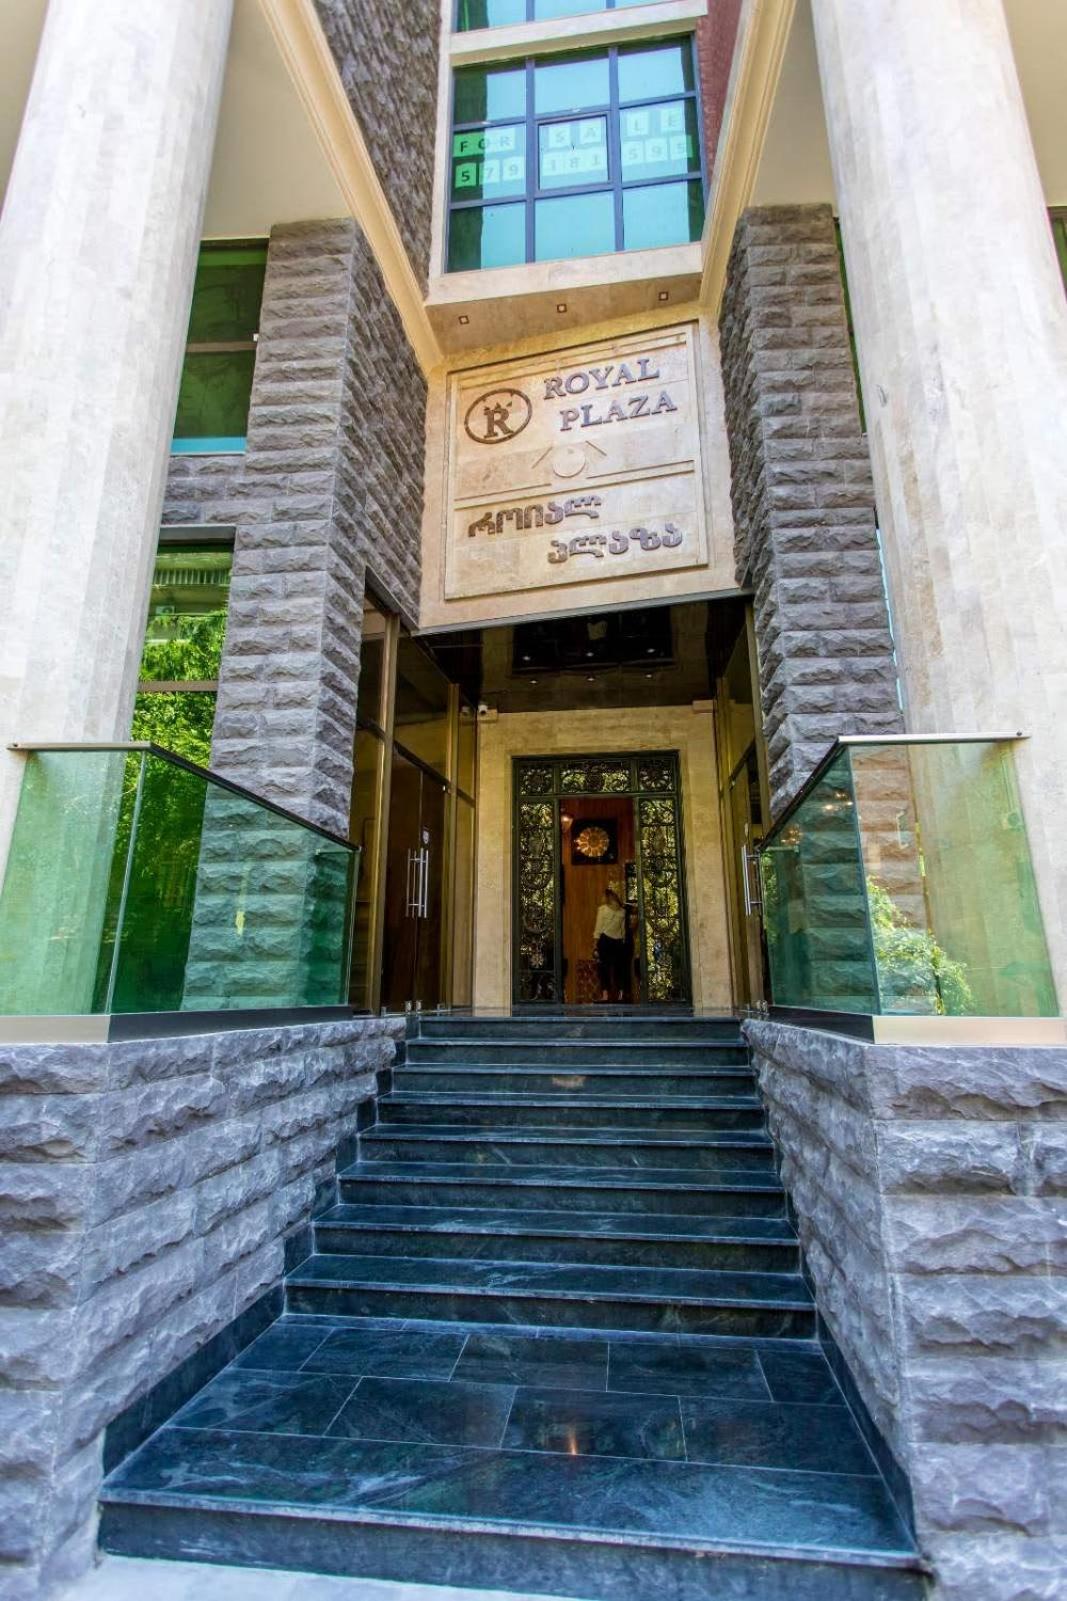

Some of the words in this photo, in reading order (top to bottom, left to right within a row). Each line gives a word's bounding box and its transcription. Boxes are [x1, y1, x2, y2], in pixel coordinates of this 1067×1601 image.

[460, 135, 512, 153] FOR
[555, 113, 679, 143] SALE
[461, 162, 519, 183] 579
[543, 358, 660, 400] ROYAL
[559, 390, 678, 432] PLAZA
[468, 495, 602, 538] როიალ
[548, 522, 684, 565] პლაზა
